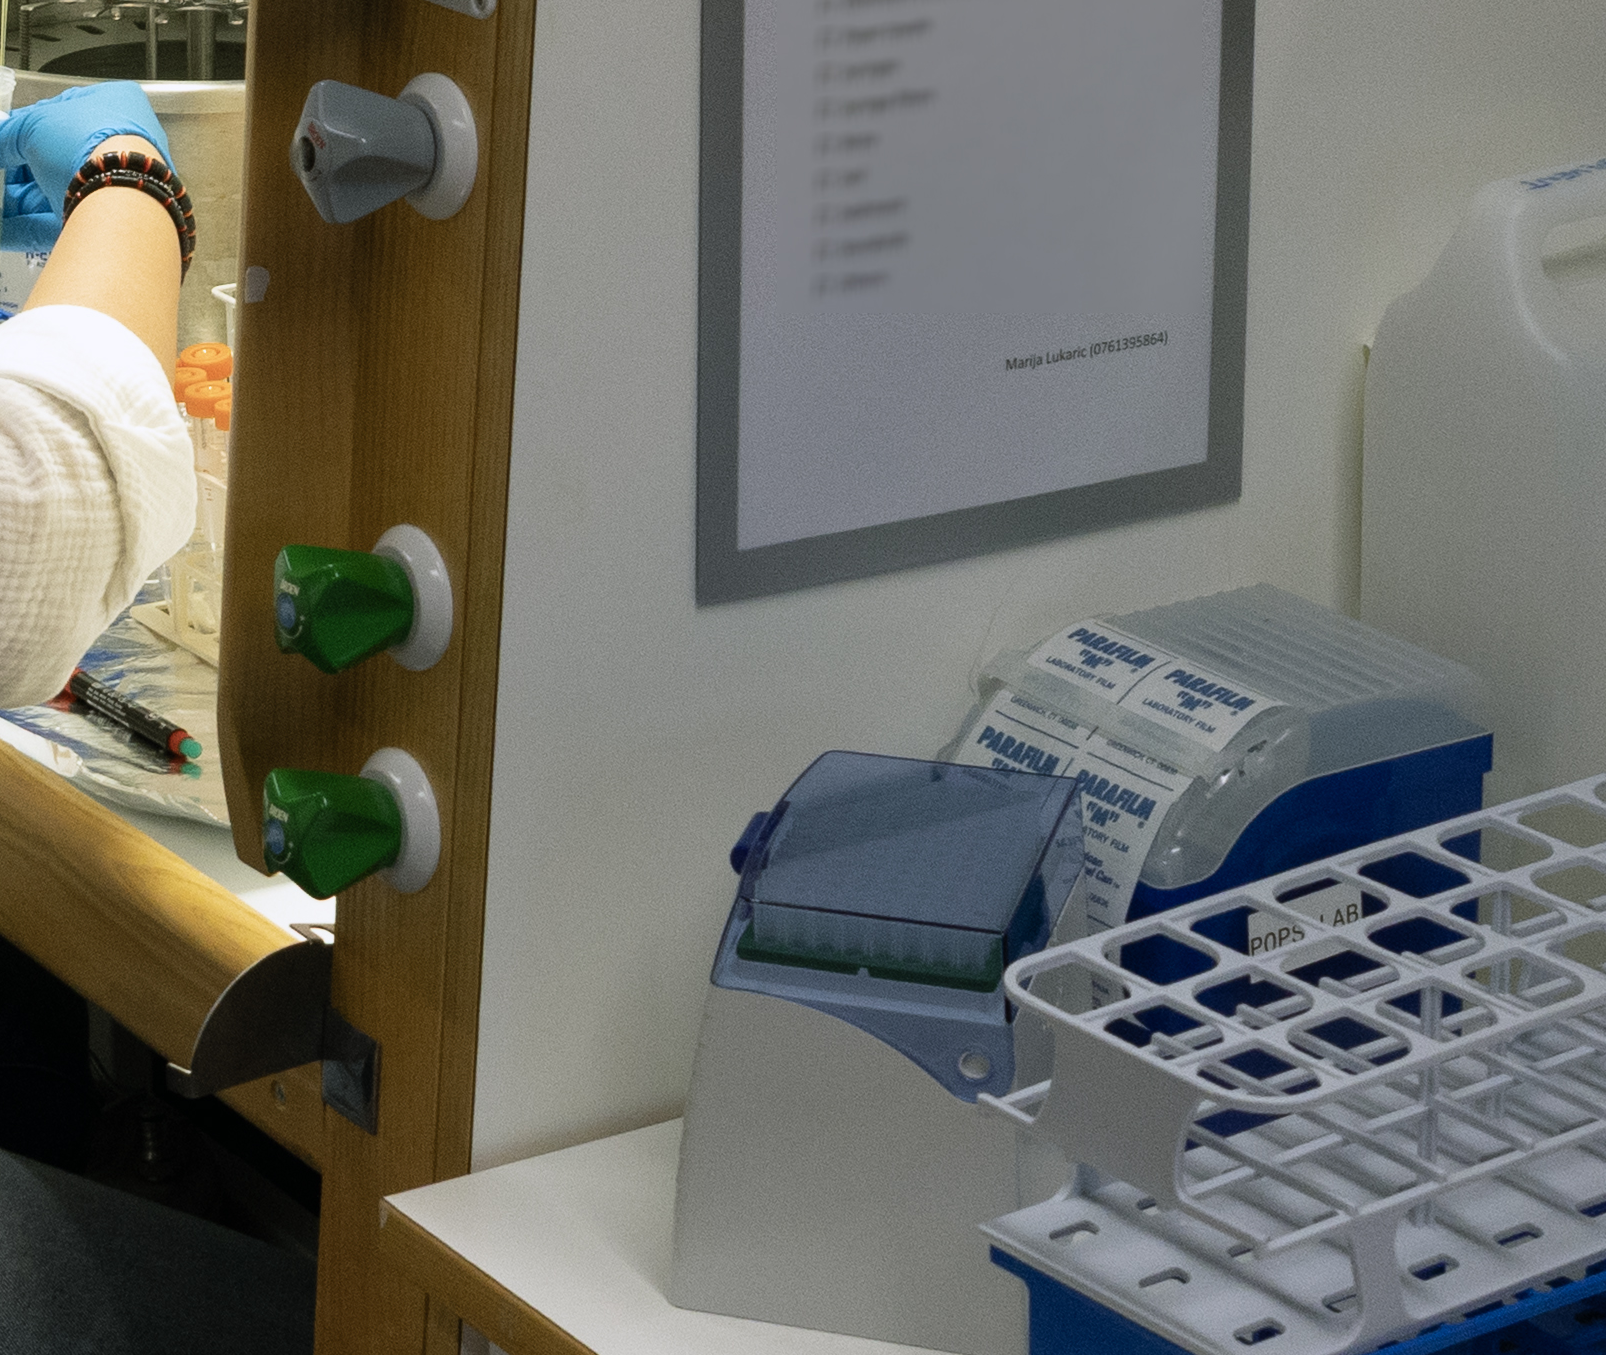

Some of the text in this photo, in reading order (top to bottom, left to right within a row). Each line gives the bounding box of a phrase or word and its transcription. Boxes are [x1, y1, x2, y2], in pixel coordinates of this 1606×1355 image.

[1005, 330, 1169, 371] Marija Lukaric (0761395864)
[1067, 627, 1157, 670] PARAFILM
[1045, 655, 1117, 691] LABORATORY FILM
[1164, 668, 1256, 712] PARAFILM
[1142, 697, 1217, 735] LABORATORY FILM
[976, 725, 1060, 776] PARAFILM
[1076, 768, 1157, 821] PARAFILM
[1109, 838, 1130, 854] FILM
[1250, 925, 1305, 956] POPS
